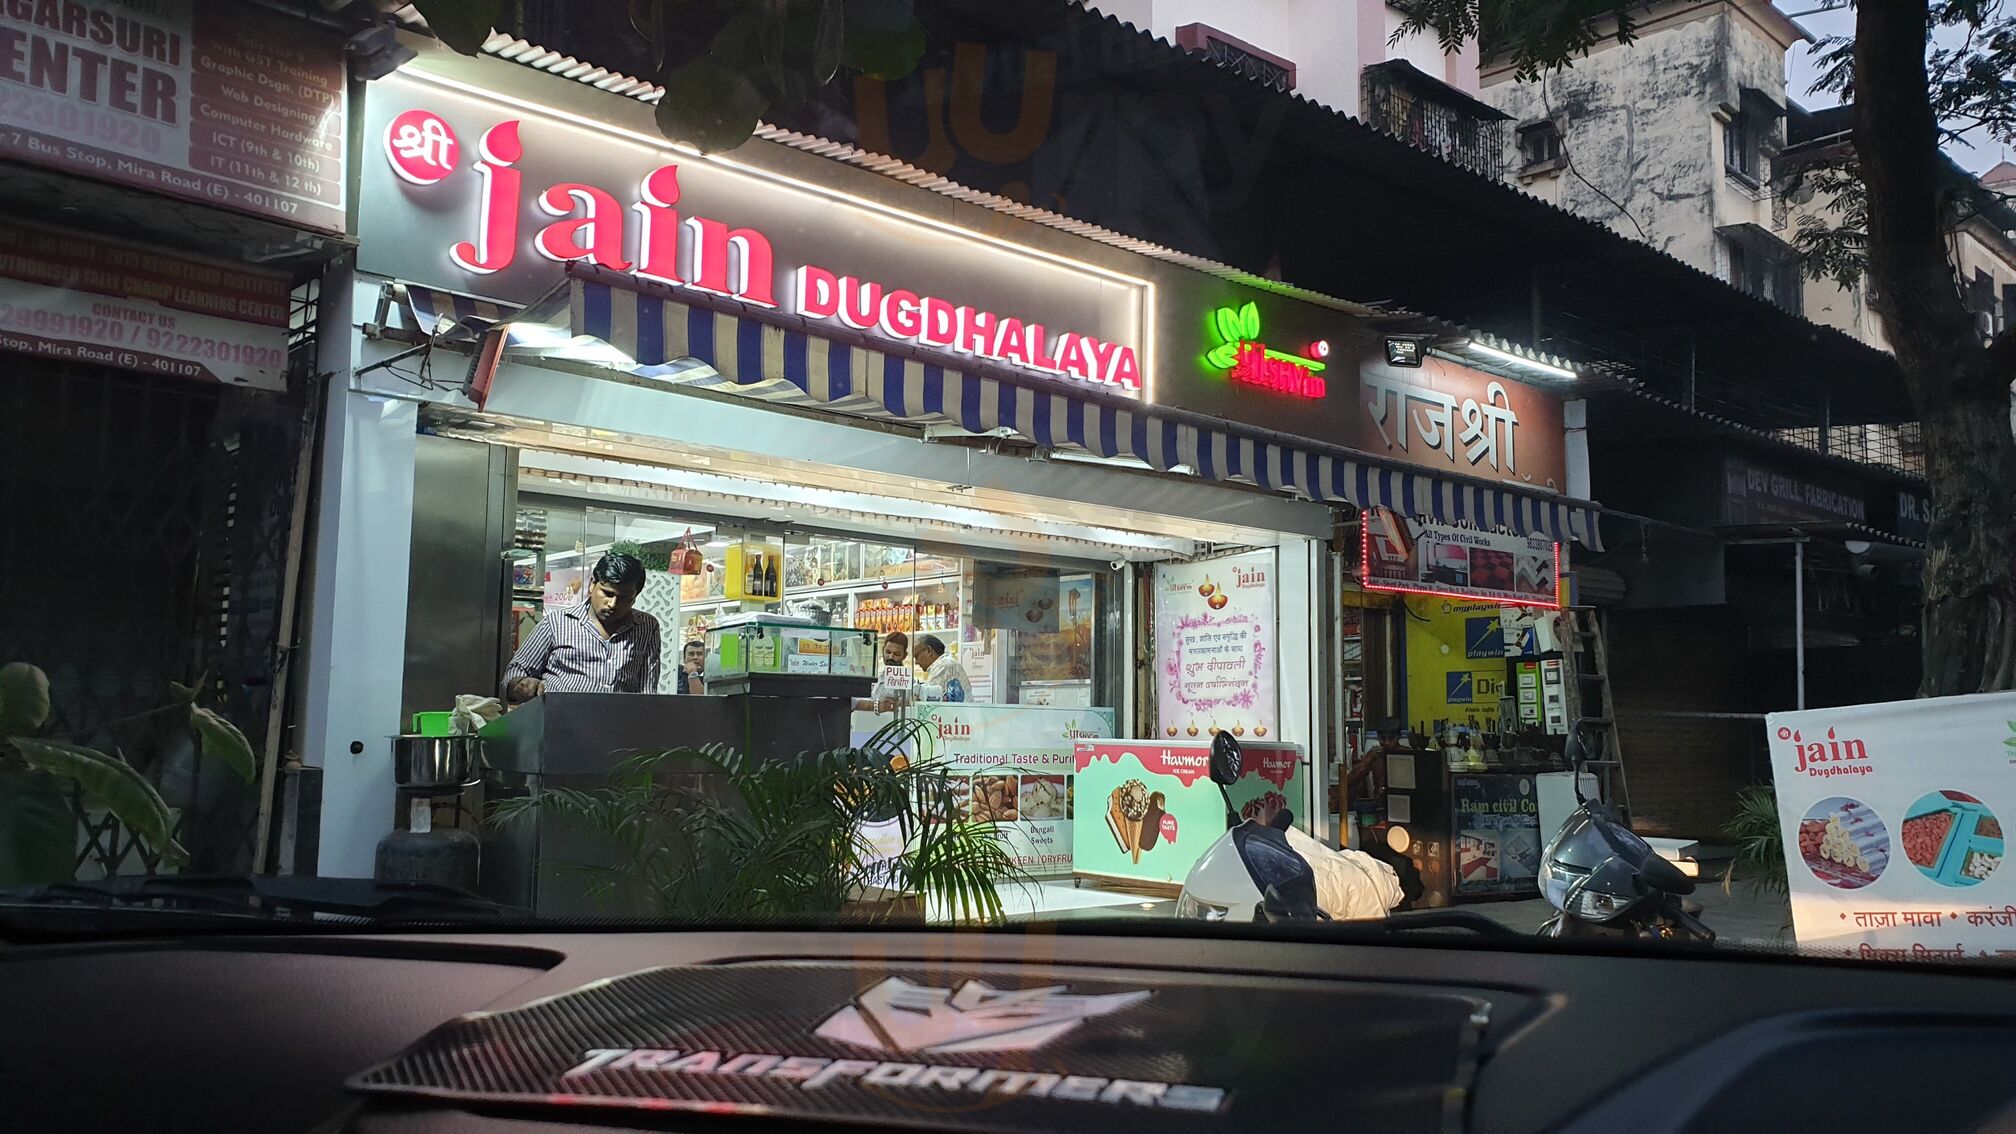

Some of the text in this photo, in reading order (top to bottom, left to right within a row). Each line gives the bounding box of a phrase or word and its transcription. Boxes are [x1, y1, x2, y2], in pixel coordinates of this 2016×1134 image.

[0, 0, 182, 67] GARSURI
[201, 56, 334, 104] Graphic Dsgn. (DTP)
[278, 60, 328, 87] Training
[220, 85, 317, 125] Web Designing
[200, 104, 333, 151] Computer Hardware
[393, 117, 453, 172] श्री
[212, 131, 320, 173] ICT (9th & 10th)
[28, 137, 60, 155] Bus
[118, 159, 156, 180] Mira
[161, 170, 201, 191] Road
[206, 180, 229, 198] (E)
[244, 191, 299, 214] 401107
[210, 155, 322, 196] IT (11th & 12 th)
[449, 119, 779, 310] jain
[92, 302, 176, 328] CONTACT US
[174, 285, 237, 313] LEARNING
[239, 297, 286, 320] CENTER
[796, 265, 1142, 391] DUGDHALAYA
[38, 340, 72, 356] Mira
[77, 346, 114, 362] Road
[118, 353, 138, 369] (E)
[151, 358, 201, 377] 401107
[1363, 374, 1520, 477] राजश्री
[1747, 468, 1768, 493] DEV
[1771, 474, 1802, 501] GRILL
[1805, 484, 1866, 521] FABRICATION
[1899, 491, 1920, 521] DR.
[1434, 531, 1451, 543] Types
[1452, 532, 1459, 541] Of
[1460, 534, 1473, 544] Civil
[1474, 537, 1491, 547] Works
[1236, 566, 1265, 588] jain
[1185, 655, 1246, 677] शुभ दीपावली
[1467, 649, 1504, 658] playwin
[886, 667, 911, 677] PULL
[936, 716, 971, 740] jain
[954, 753, 1008, 765] Traditional
[1011, 753, 1039, 765] Taste
[1041, 754, 1049, 764] &
[1160, 749, 1209, 767] Havmor
[1262, 757, 1292, 769] Havmor
[1793, 726, 1868, 772] jain
[1808, 764, 1873, 778] Dugdhalaya
[1460, 798, 1489, 813] Ram
[1492, 798, 1517, 813] civil
[1853, 911, 1898, 928] ताज़ा
[1901, 911, 1942, 928] मावा
[562, 1048, 1226, 1113] TRANSFORMERS
